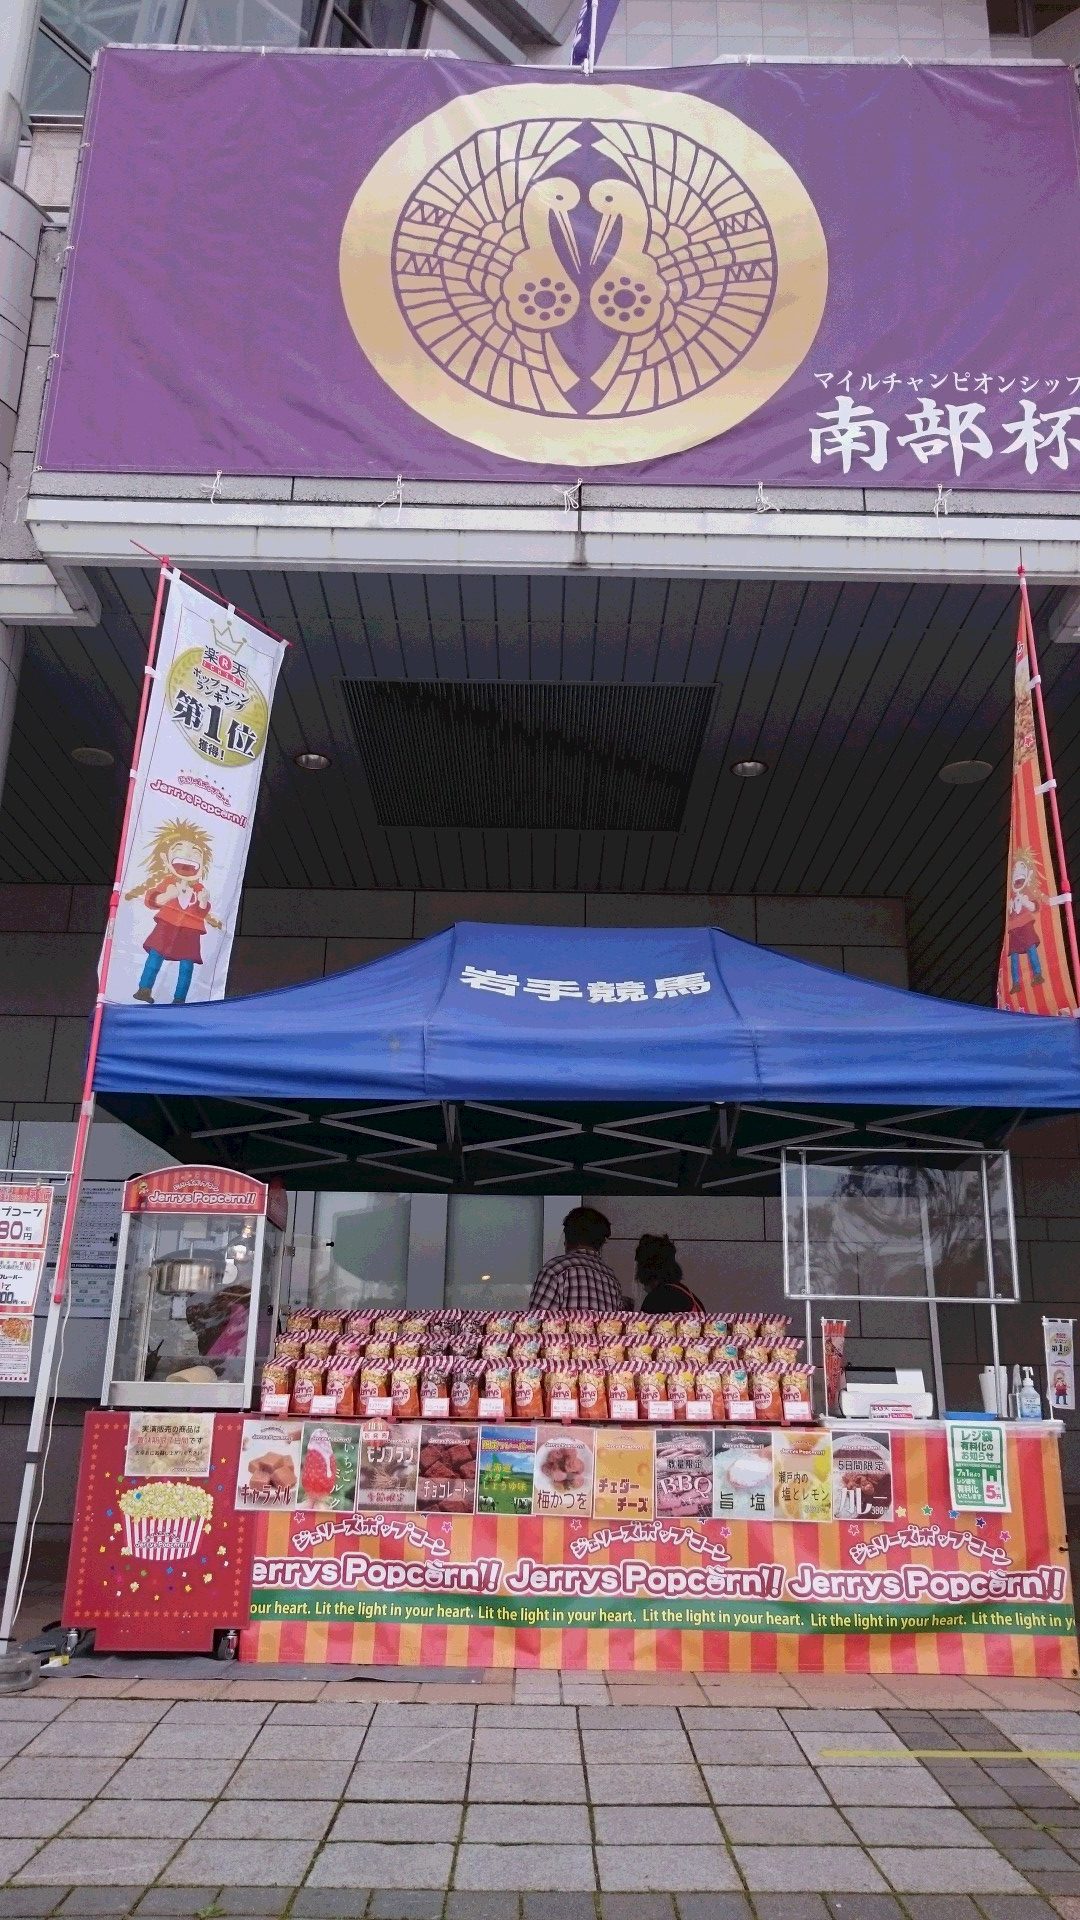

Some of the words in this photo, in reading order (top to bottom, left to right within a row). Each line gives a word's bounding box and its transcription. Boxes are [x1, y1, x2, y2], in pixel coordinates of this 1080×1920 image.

[808, 395, 1080, 477] 南部杯
[193, 667, 251, 704] ポップコーン
[196, 681, 246, 711] ランキング
[172, 690, 256, 758] 第1位
[150, 778, 193, 804] Jerrys
[459, 965, 711, 1003] 岩手競馬
[148, 1189, 193, 1204] Jerrys
[193, 1191, 257, 1205] Popcorn!!
[960, 1441, 994, 1452] 有料化の
[961, 1430, 993, 1442] レジ袋
[342, 1443, 355, 1482] いちご
[838, 1460, 884, 1471] 5日間限定
[961, 1452, 994, 1461] お知らせ
[329, 1468, 343, 1508] ミルク
[423, 1481, 469, 1498] チョコレート
[598, 1477, 640, 1494] チェダー
[659, 1474, 713, 1498] BBQ
[778, 1471, 809, 1484] 瀬戸内の
[240, 1484, 292, 1505] キャラメル
[537, 1489, 588, 1510] 梅かつを
[617, 1497, 649, 1512] チーズ
[782, 1487, 830, 1502] 塩とレモン
[292, 1514, 450, 1557] ジェリーズポップコーン
[570, 1520, 732, 1562] ジェリーズポップコーン
[848, 1524, 1013, 1566] ジェリーズポップコーン
[341, 1553, 503, 1594] Popcorn!!
[507, 1558, 620, 1596] Jerrys
[620, 1558, 786, 1599] Popcorn!!
[787, 1563, 902, 1601] Jerrys
[902, 1563, 1067, 1603] Popcorn!!
[274, 1602, 311, 1615] heart.
[315, 1603, 333, 1615] Lit
[334, 1603, 354, 1616] the
[358, 1602, 387, 1619] light
[390, 1604, 402, 1617] in
[404, 1606, 435, 1620] your
[437, 1604, 474, 1619] heart.
[479, 1606, 494, 1620] Lit
[496, 1606, 518, 1621] the
[520, 1608, 550, 1624] light
[552, 1609, 564, 1621] in
[567, 1611, 597, 1624] your
[600, 1608, 637, 1622] heart.
[643, 1610, 660, 1622] Lit
[662, 1609, 683, 1623] the
[686, 1609, 715, 1625] light
[718, 1610, 731, 1624] in
[734, 1613, 763, 1626] your
[766, 1611, 804, 1625] heart.
[811, 1613, 828, 1627] Lit
[830, 1613, 851, 1627] the
[854, 1613, 883, 1629] light
[886, 1614, 898, 1627] in
[900, 1616, 930, 1630] your
[932, 1613, 967, 1627] heart.
[972, 1611, 989, 1625] Lit
[991, 1612, 1013, 1627] the
[1016, 1612, 1047, 1629] light
[1049, 1613, 1062, 1627] in
